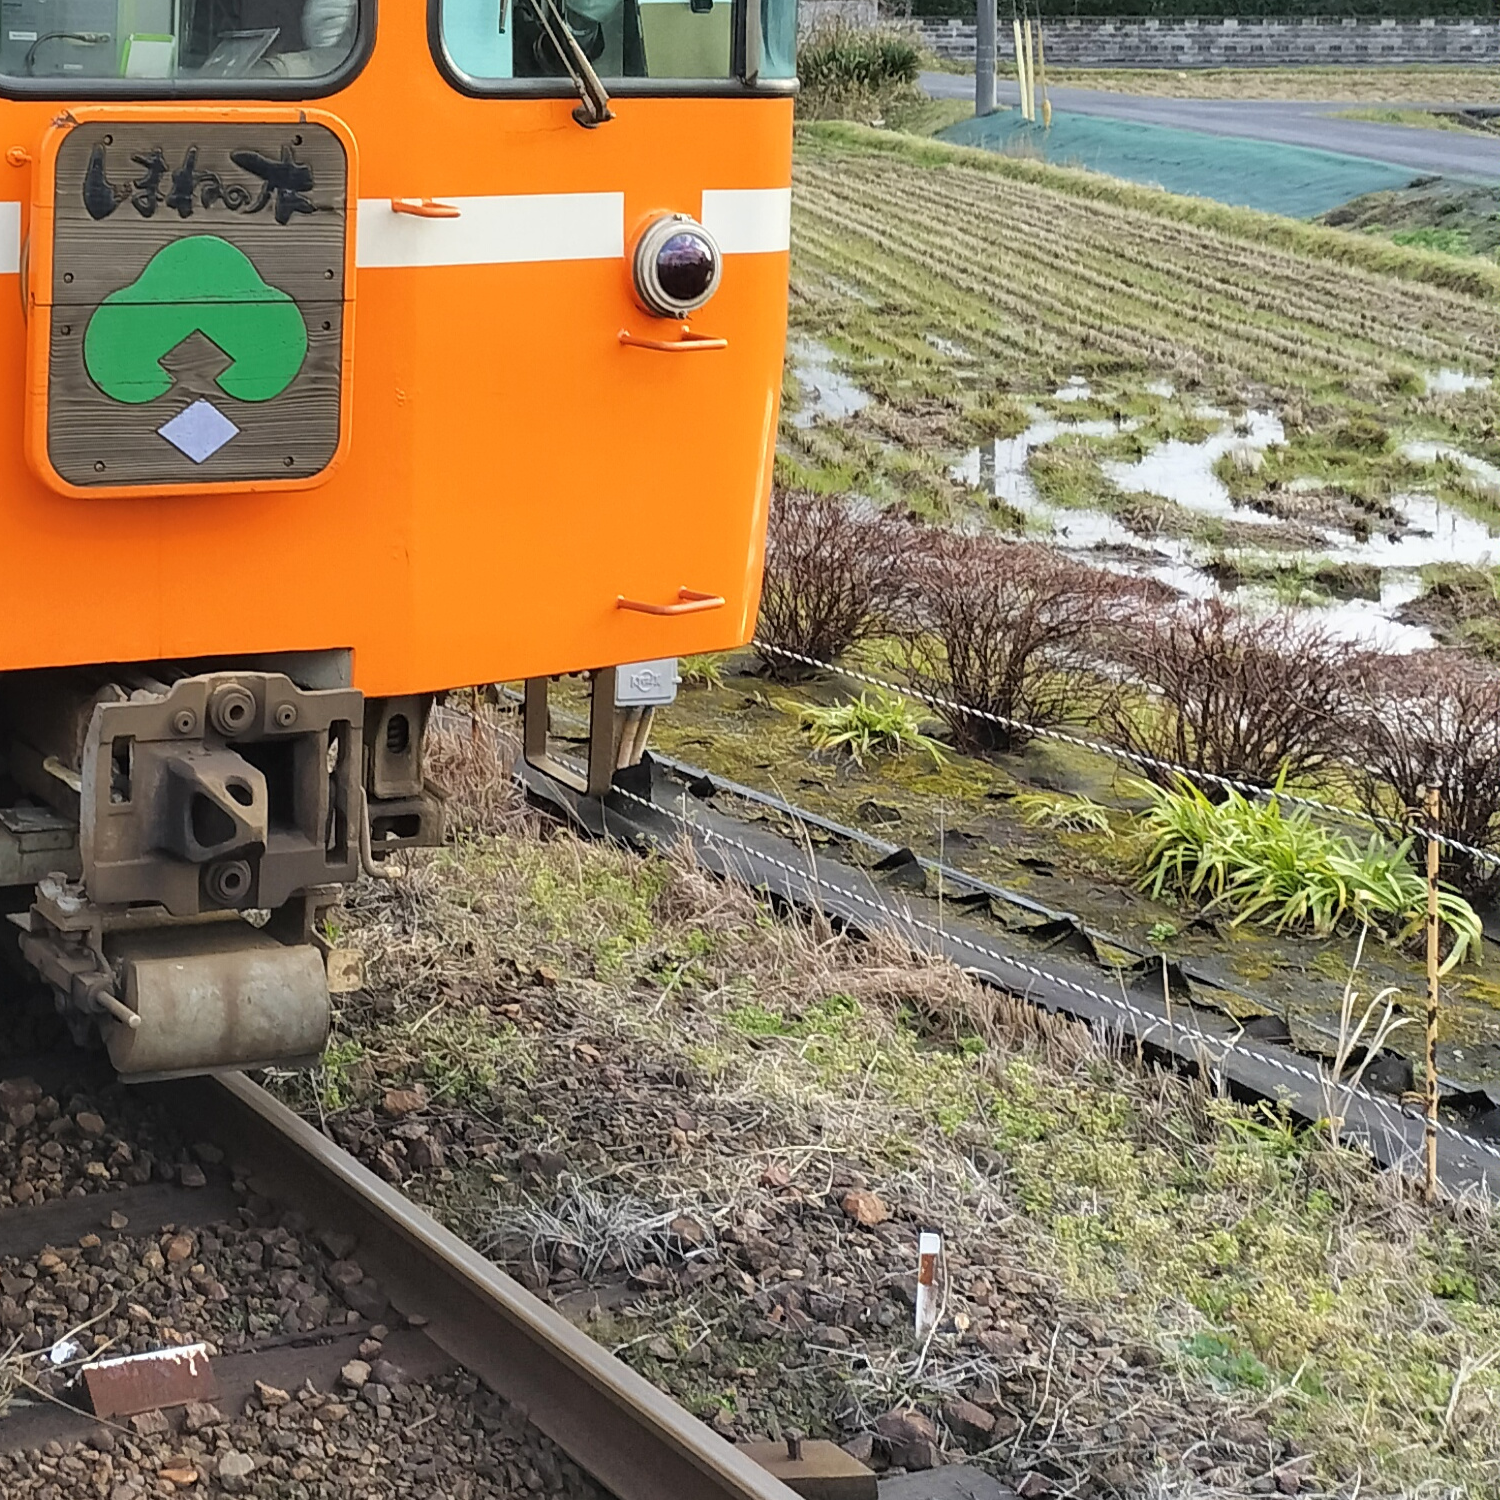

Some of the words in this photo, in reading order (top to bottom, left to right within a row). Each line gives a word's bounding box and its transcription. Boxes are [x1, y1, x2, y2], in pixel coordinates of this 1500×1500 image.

[83, 142, 317, 225] しまねの木
